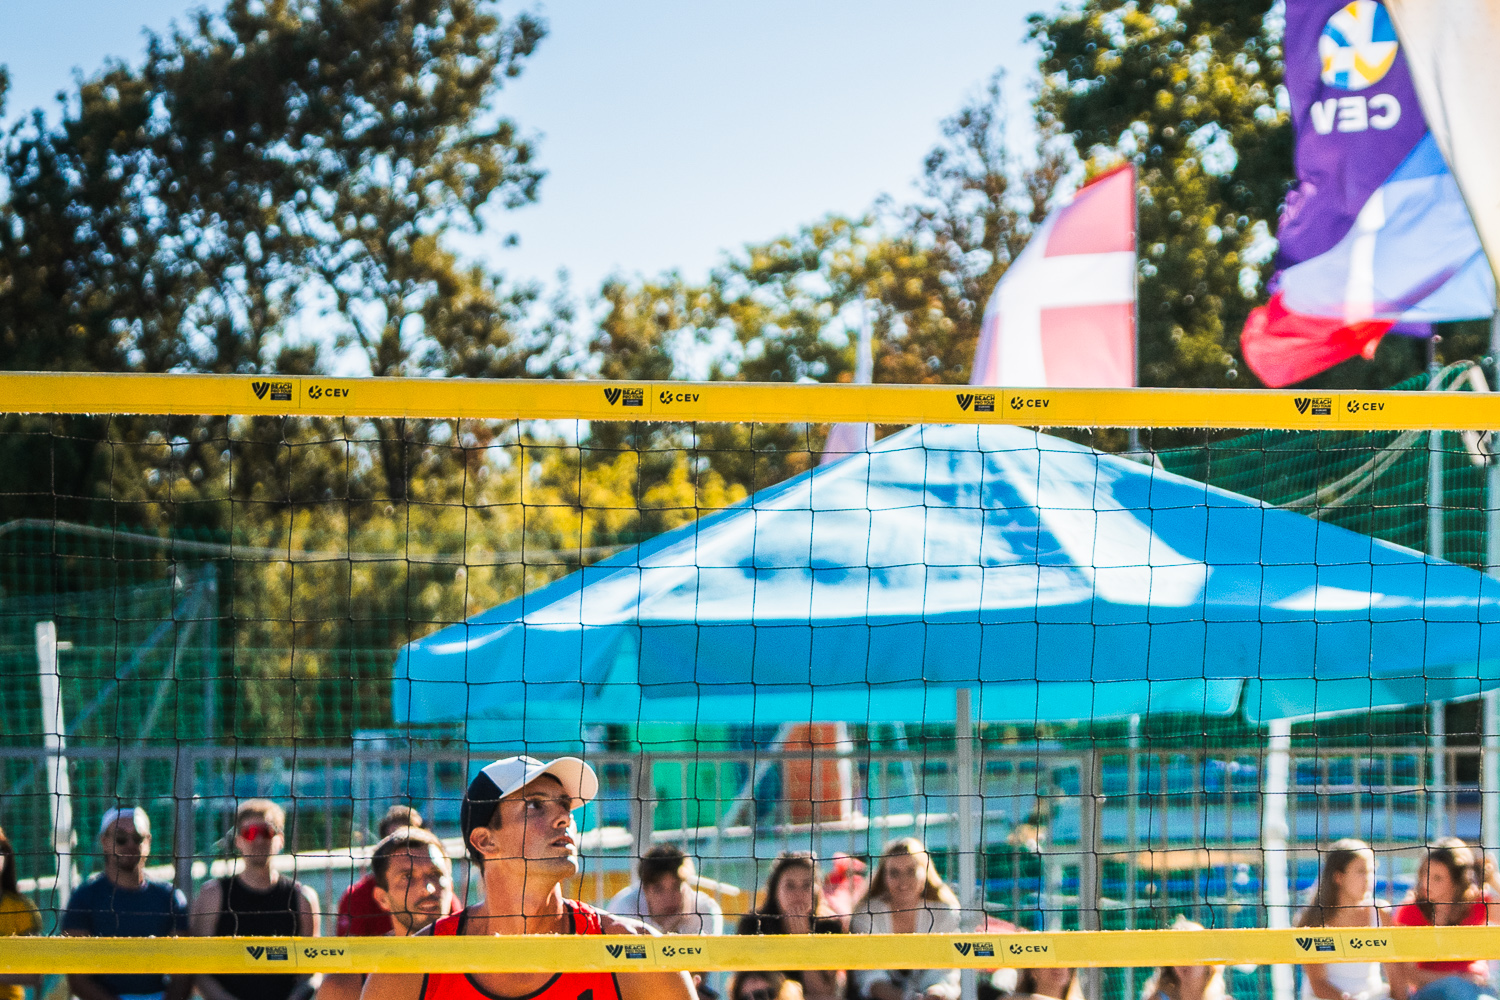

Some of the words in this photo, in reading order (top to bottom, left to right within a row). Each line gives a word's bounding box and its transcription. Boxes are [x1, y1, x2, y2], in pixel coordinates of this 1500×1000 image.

[325, 388, 350, 398] CEV
[676, 393, 700, 402] CEV
[1027, 399, 1050, 408] CEV
[1362, 402, 1385, 410] CEV
[1366, 939, 1387, 947] CEV
[679, 947, 702, 955] CEV
[1026, 945, 1048, 953] CEV
